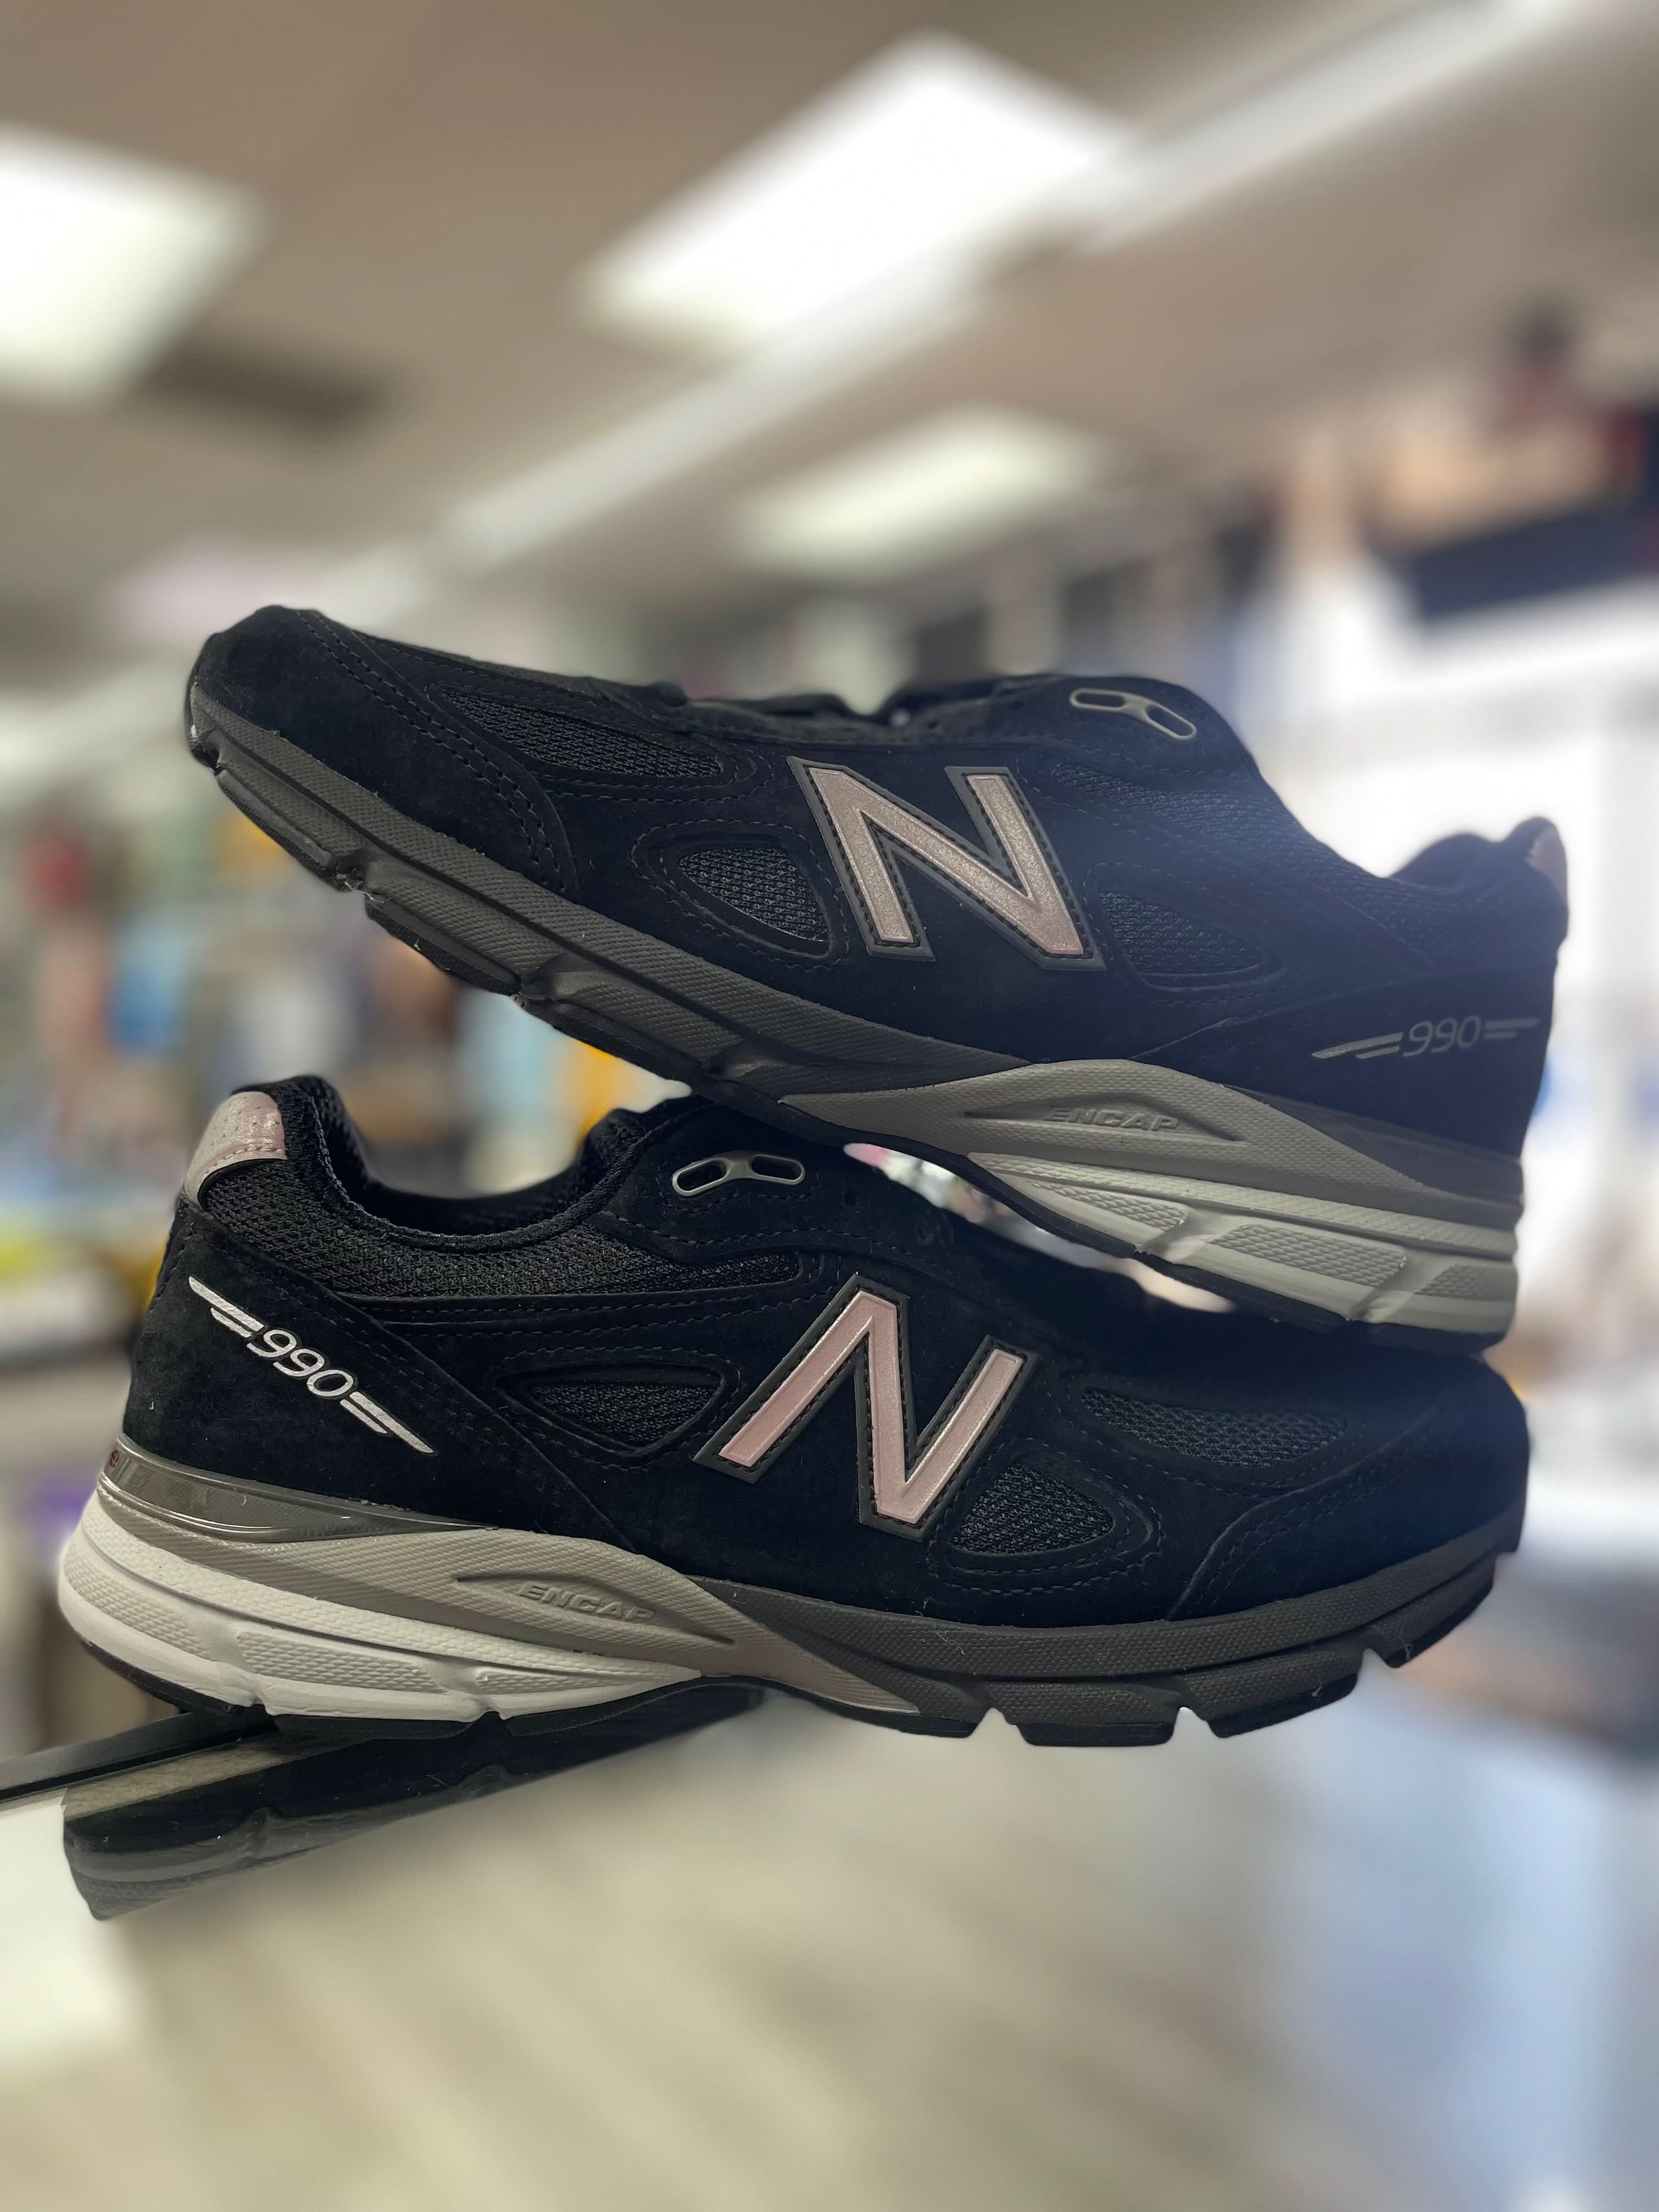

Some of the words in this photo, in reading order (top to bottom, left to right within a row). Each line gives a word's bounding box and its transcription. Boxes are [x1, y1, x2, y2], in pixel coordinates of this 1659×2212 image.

[787, 757, 1106, 970] N
[1402, 1015, 1481, 1057] 990
[1044, 1105, 1179, 1131] ENCAP
[246, 1329, 354, 1397] 990
[694, 1273, 1039, 1541] N
[518, 1581, 656, 1621] ENCAP
